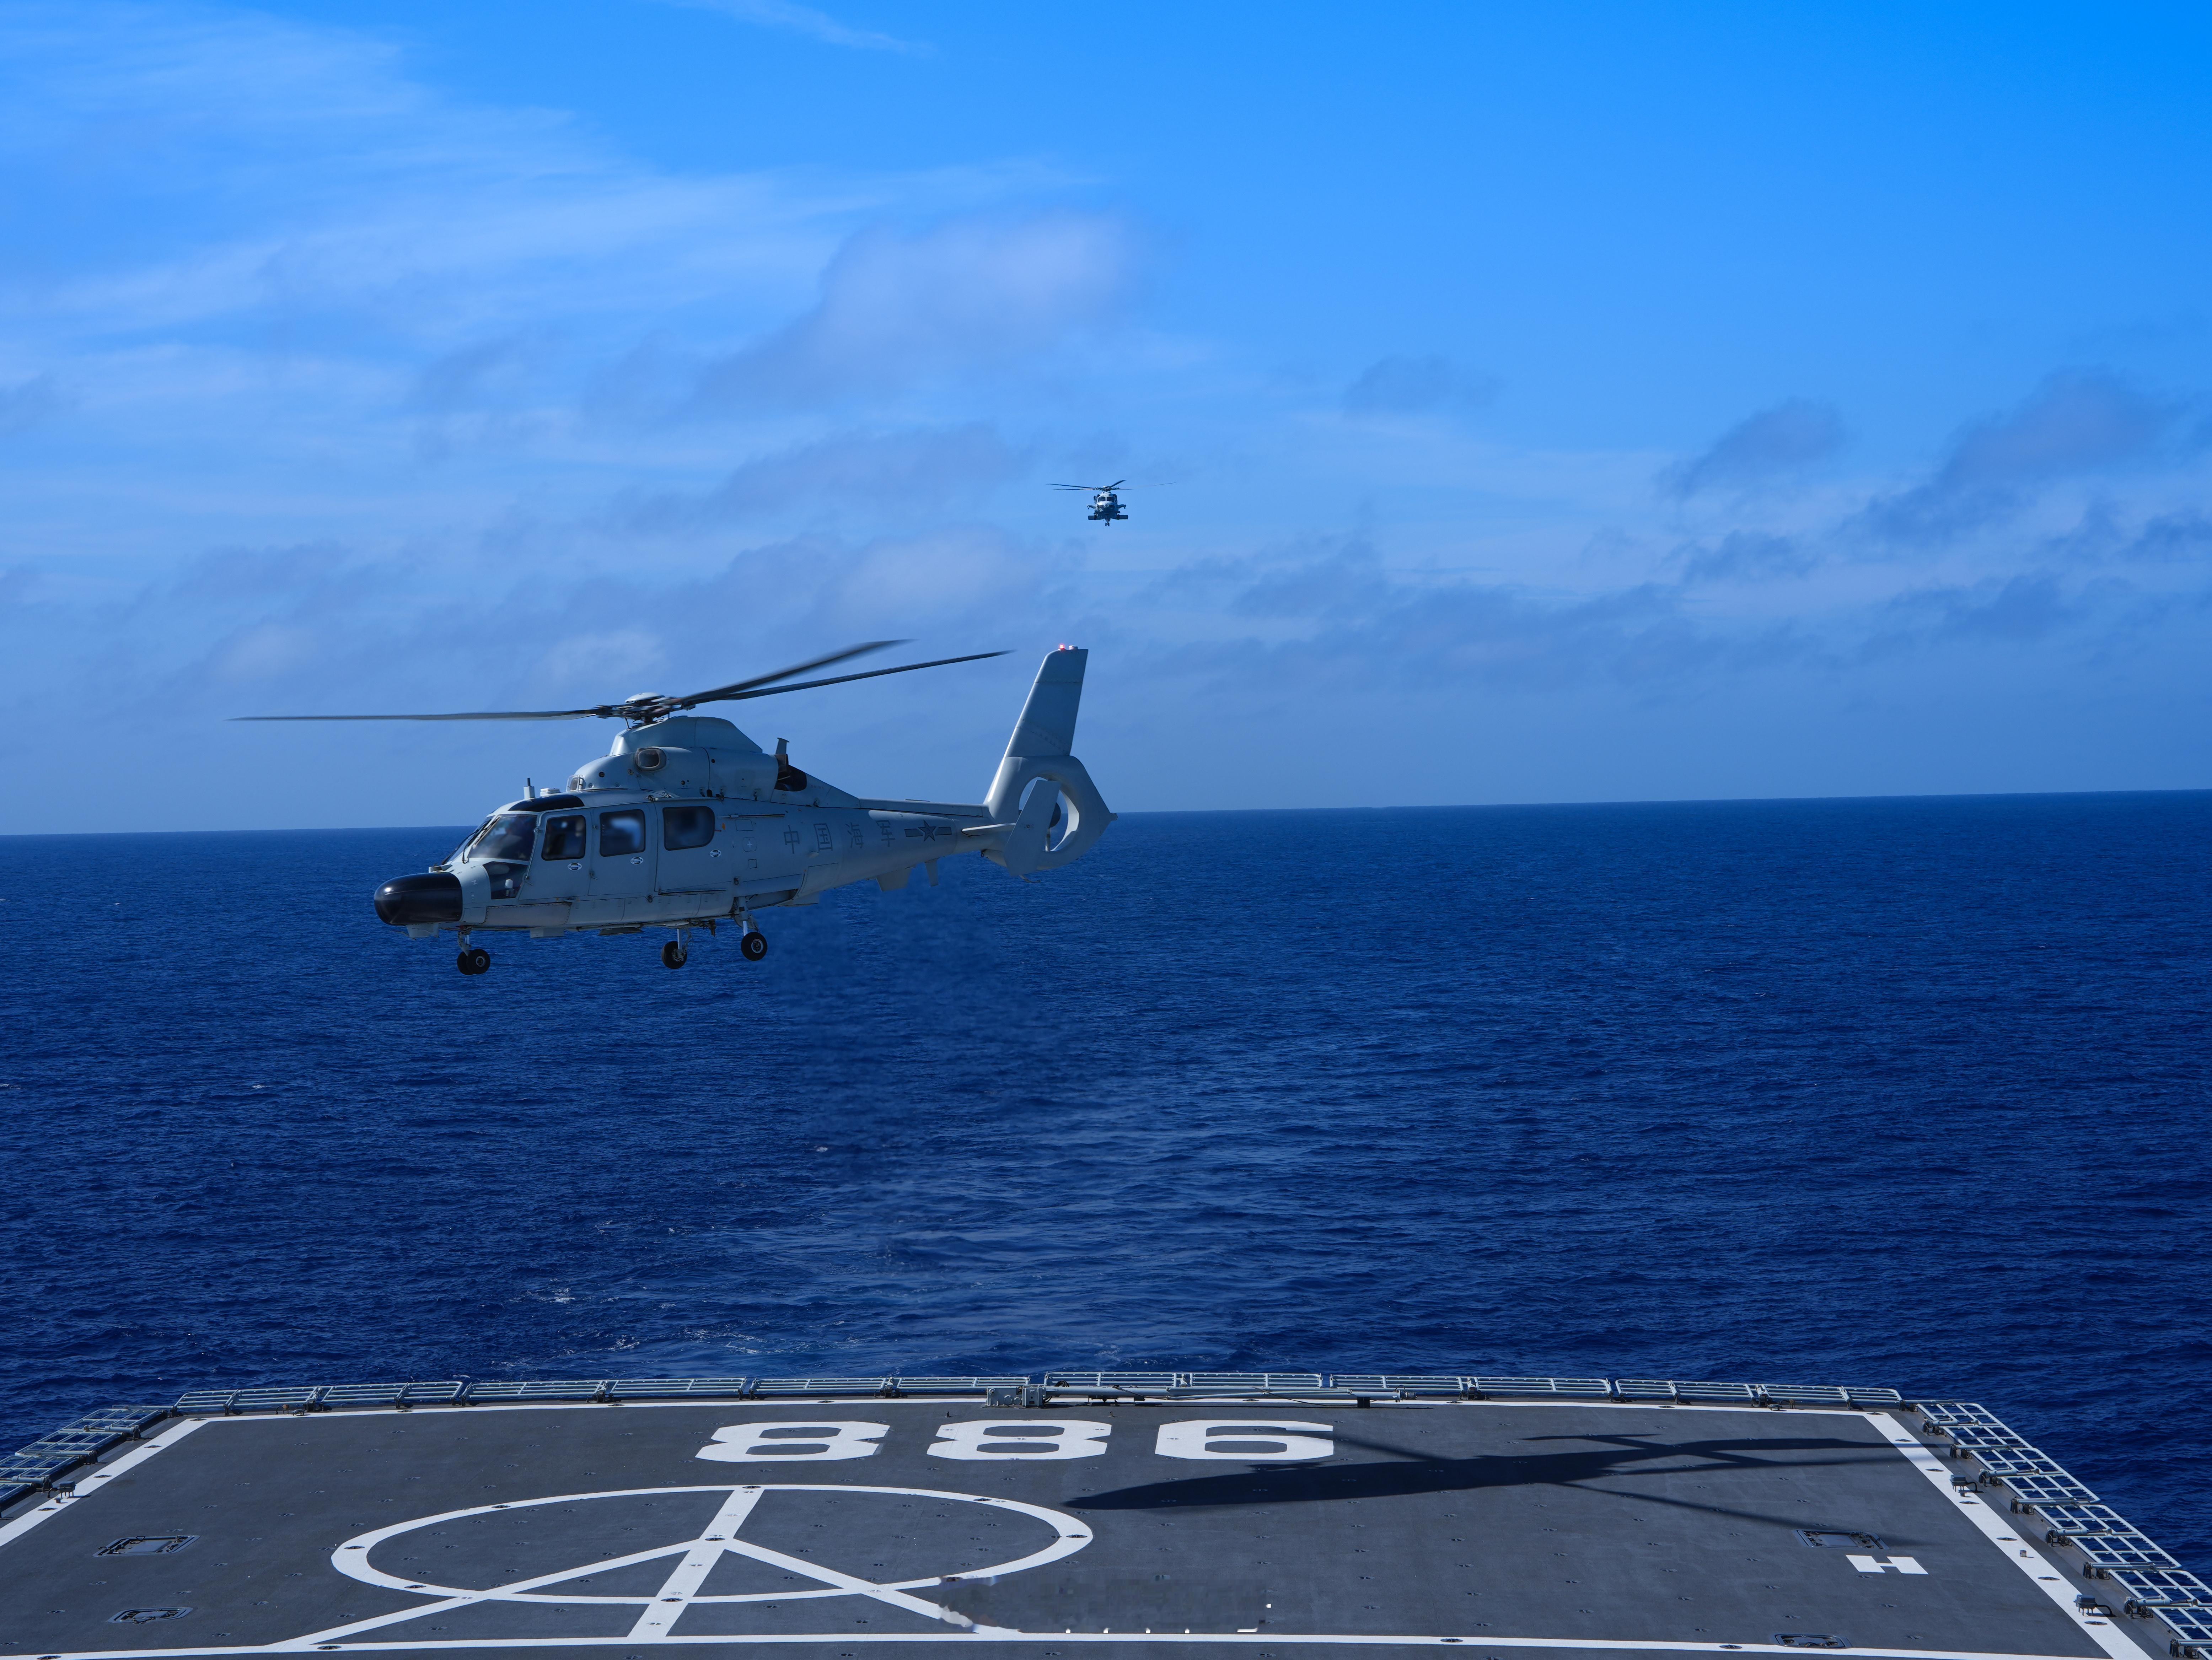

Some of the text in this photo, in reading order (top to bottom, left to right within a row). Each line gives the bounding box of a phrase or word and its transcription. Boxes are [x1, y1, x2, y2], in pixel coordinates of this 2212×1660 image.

[783, 820, 896, 854] 中国海军
[695, 1420, 1333, 1462] 886
